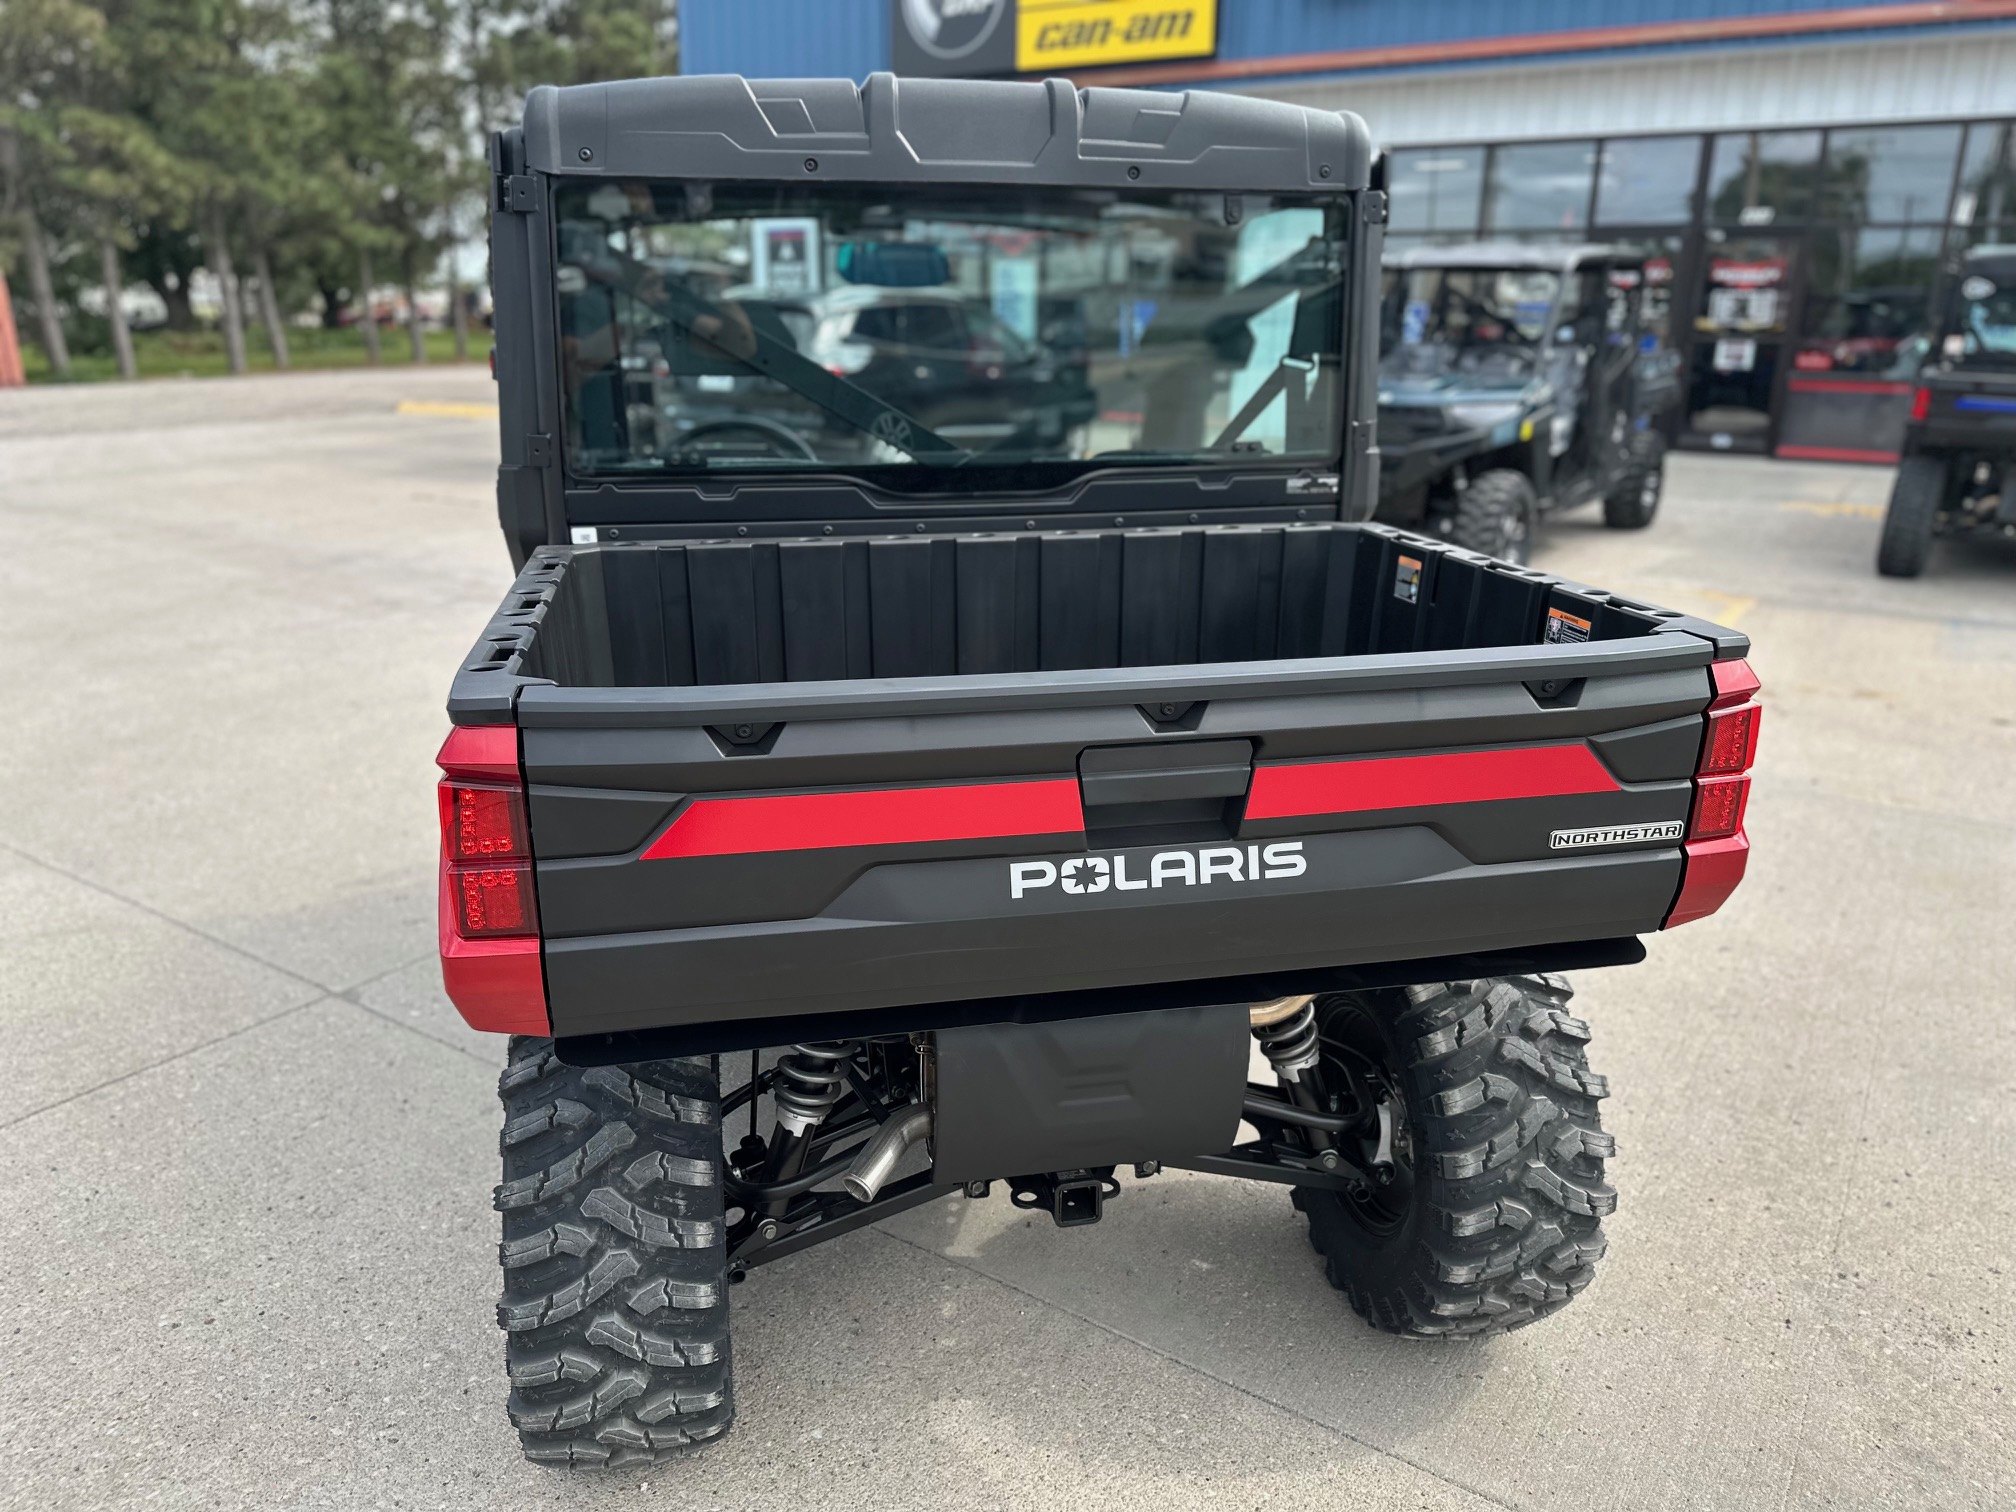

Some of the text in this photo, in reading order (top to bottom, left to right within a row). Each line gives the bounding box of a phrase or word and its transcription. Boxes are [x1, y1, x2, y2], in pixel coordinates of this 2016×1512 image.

[1035, 10, 1195, 52] can-am
[1556, 825, 1679, 847] NORTHSTAR
[1009, 841, 1308, 900] POLARIS
